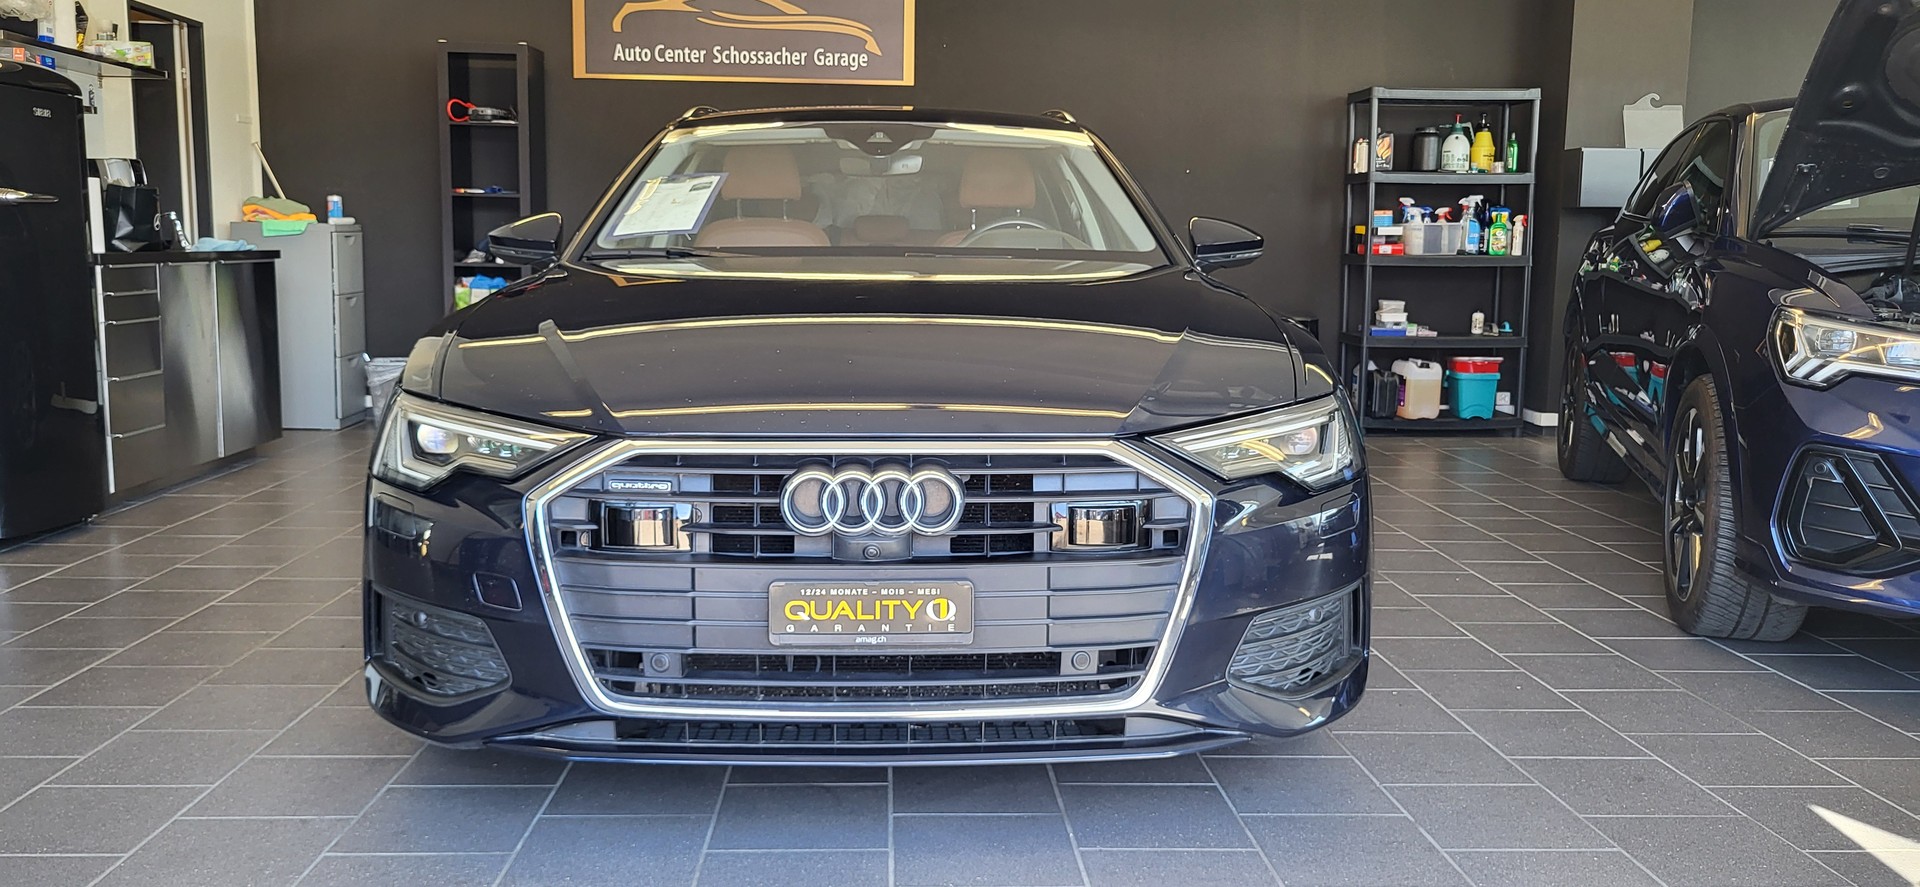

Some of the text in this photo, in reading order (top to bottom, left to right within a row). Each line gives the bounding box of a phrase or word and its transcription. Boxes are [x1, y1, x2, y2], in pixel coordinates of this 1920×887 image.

[613, 43, 868, 70] Auto Center Schossacher Garage
[800, 588, 826, 596] 12/24
[830, 588, 868, 596] MONATE
[881, 588, 905, 596] MOIS
[917, 588, 941, 596] MESI
[784, 600, 923, 621] QUALITY
[786, 624, 955, 632] GARANTIE
[855, 636, 887, 644] amag.ch
